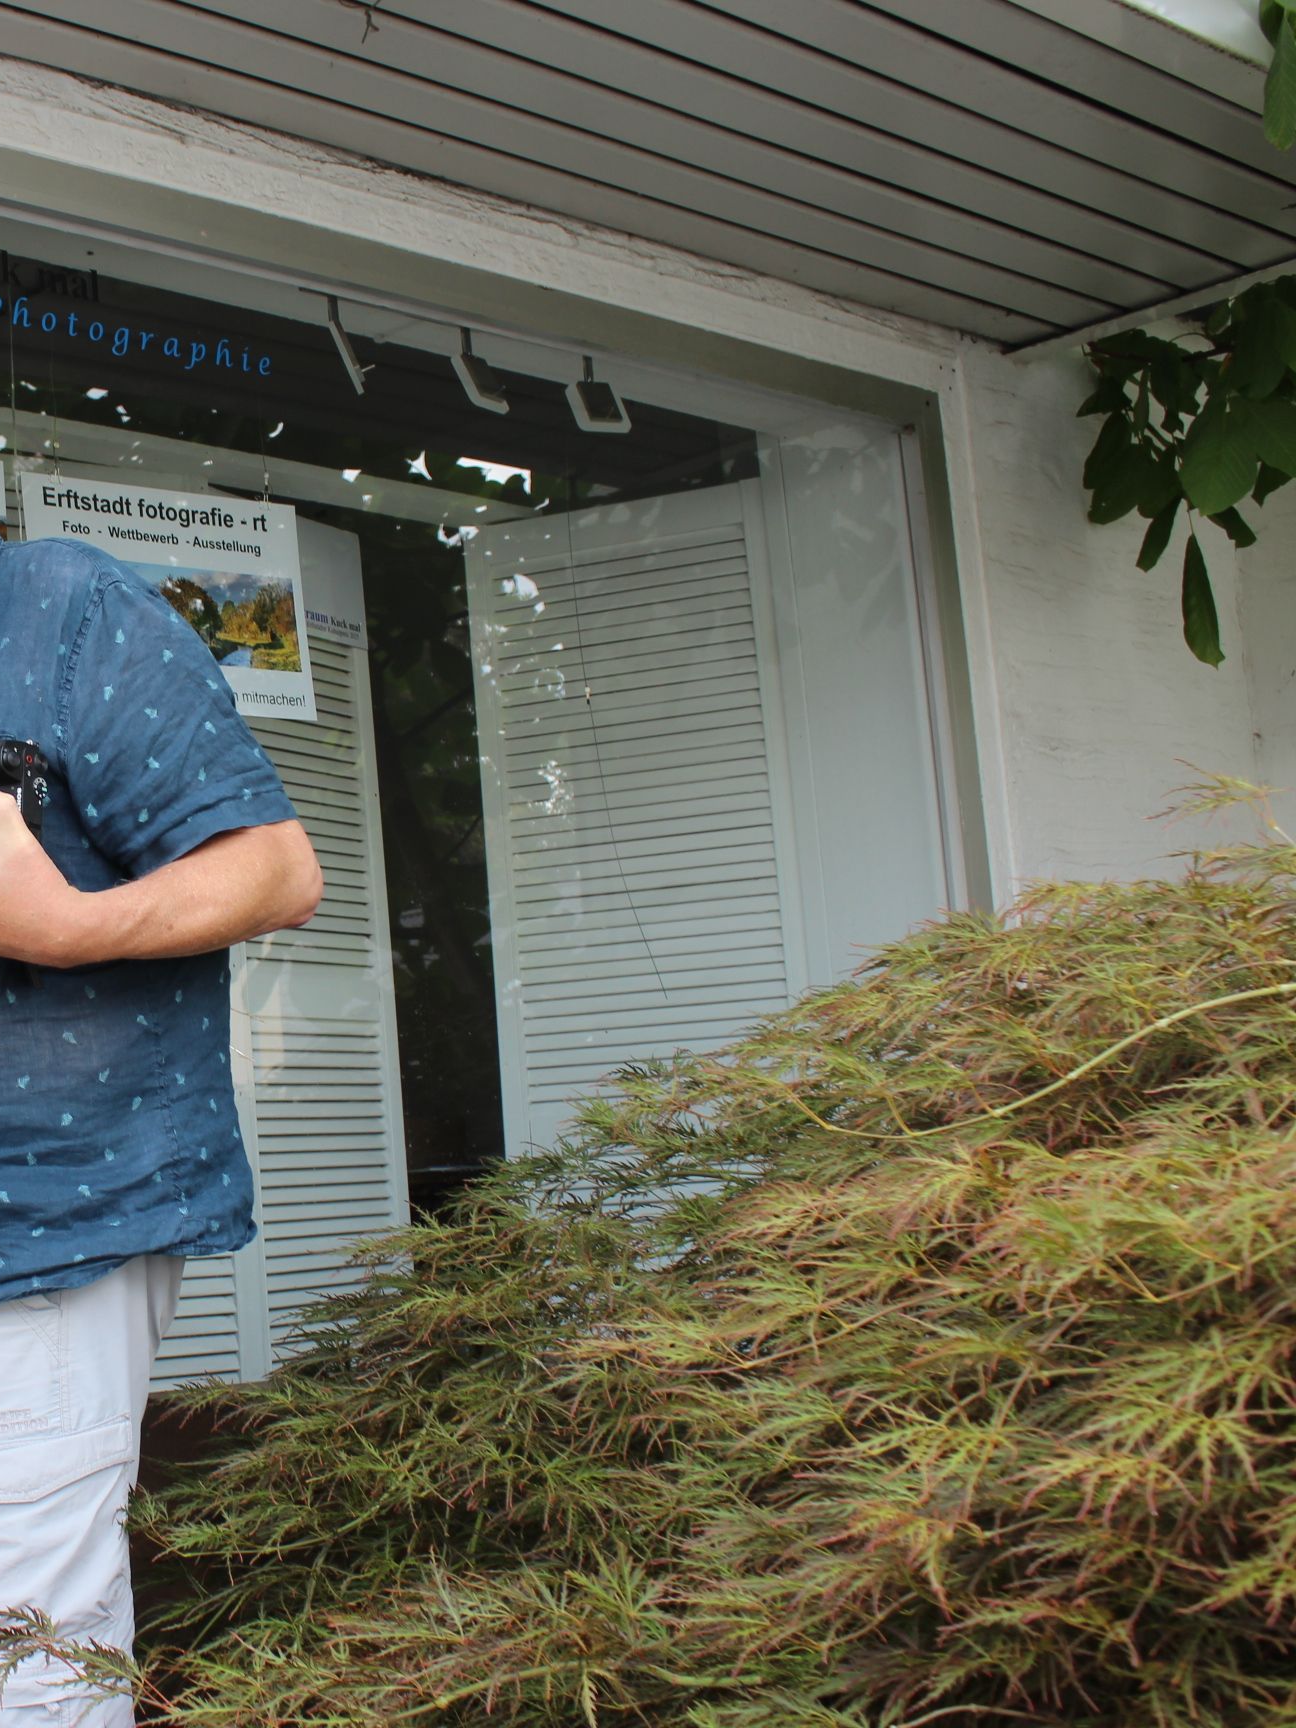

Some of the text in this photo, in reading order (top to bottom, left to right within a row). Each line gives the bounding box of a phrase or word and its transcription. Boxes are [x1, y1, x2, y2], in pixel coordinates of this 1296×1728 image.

[37, 268, 100, 302] mal
[42, 486, 132, 518] Erftstadt
[137, 498, 234, 528] fotografie
[252, 514, 268, 533] rt
[62, 520, 91, 536] Foto
[108, 525, 179, 546] Wettbewerb
[193, 535, 262, 557] Ausstellung
[242, 691, 306, 708] mitmachen!
